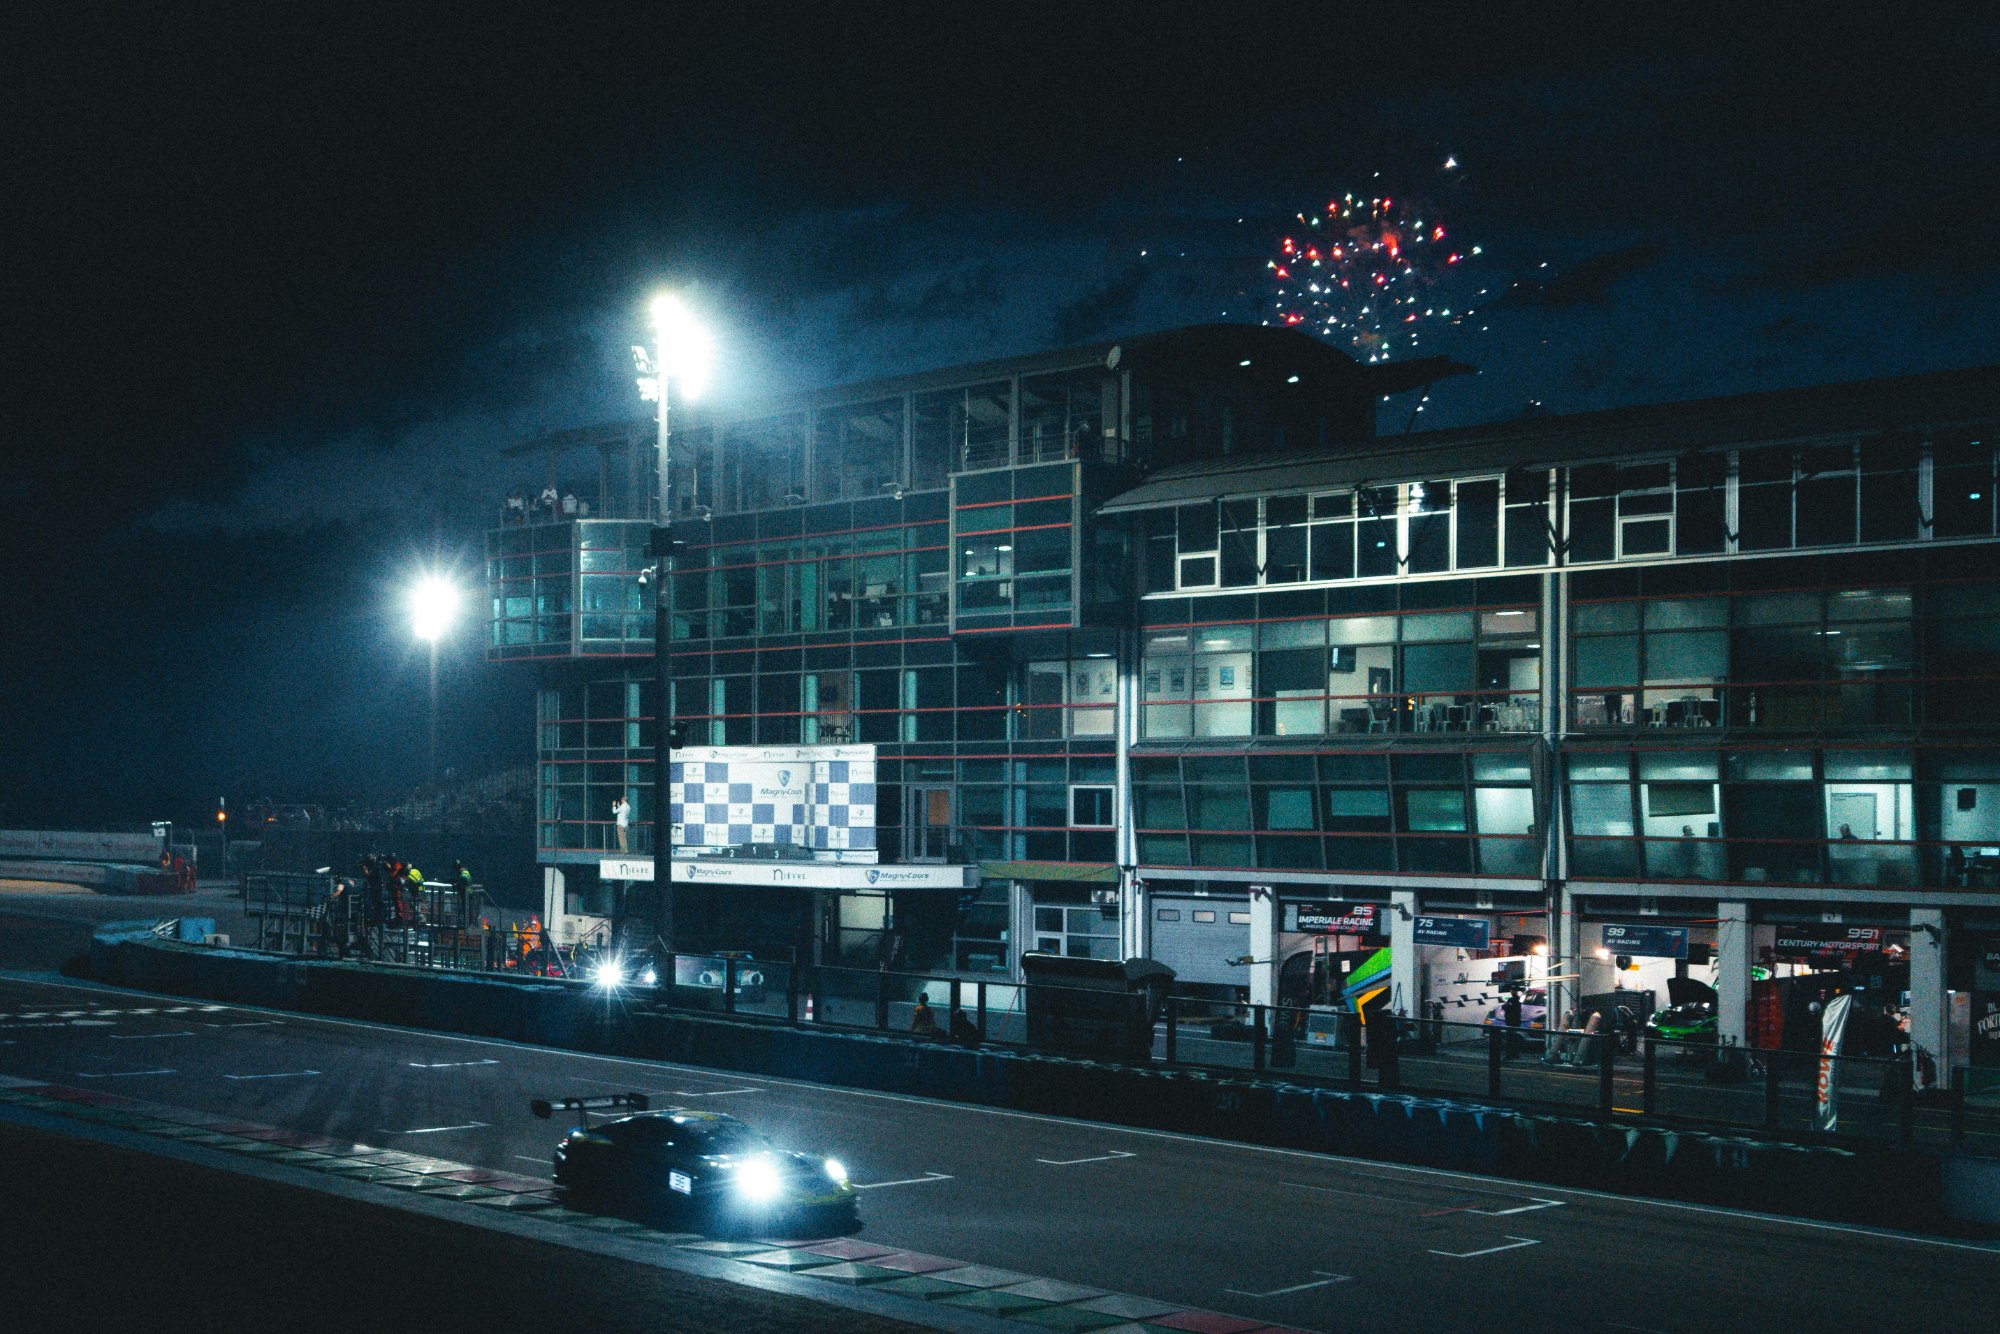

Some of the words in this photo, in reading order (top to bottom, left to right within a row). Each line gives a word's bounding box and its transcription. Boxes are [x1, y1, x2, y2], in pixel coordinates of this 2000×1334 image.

[729, 849, 735, 857] 2
[774, 850, 779, 858] 3
[880, 872, 929, 880] Magny-Cours
[1353, 905, 1373, 916] 85
[1298, 915, 1342, 925] IMPERIALE
[1343, 917, 1374, 926] RACING
[1418, 918, 1434, 928] 75
[1607, 927, 1626, 937] 99
[1847, 928, 1880, 939] 991
[1777, 938, 1819, 947] CENTURY
[1820, 941, 1881, 950] MOTORSPORT
